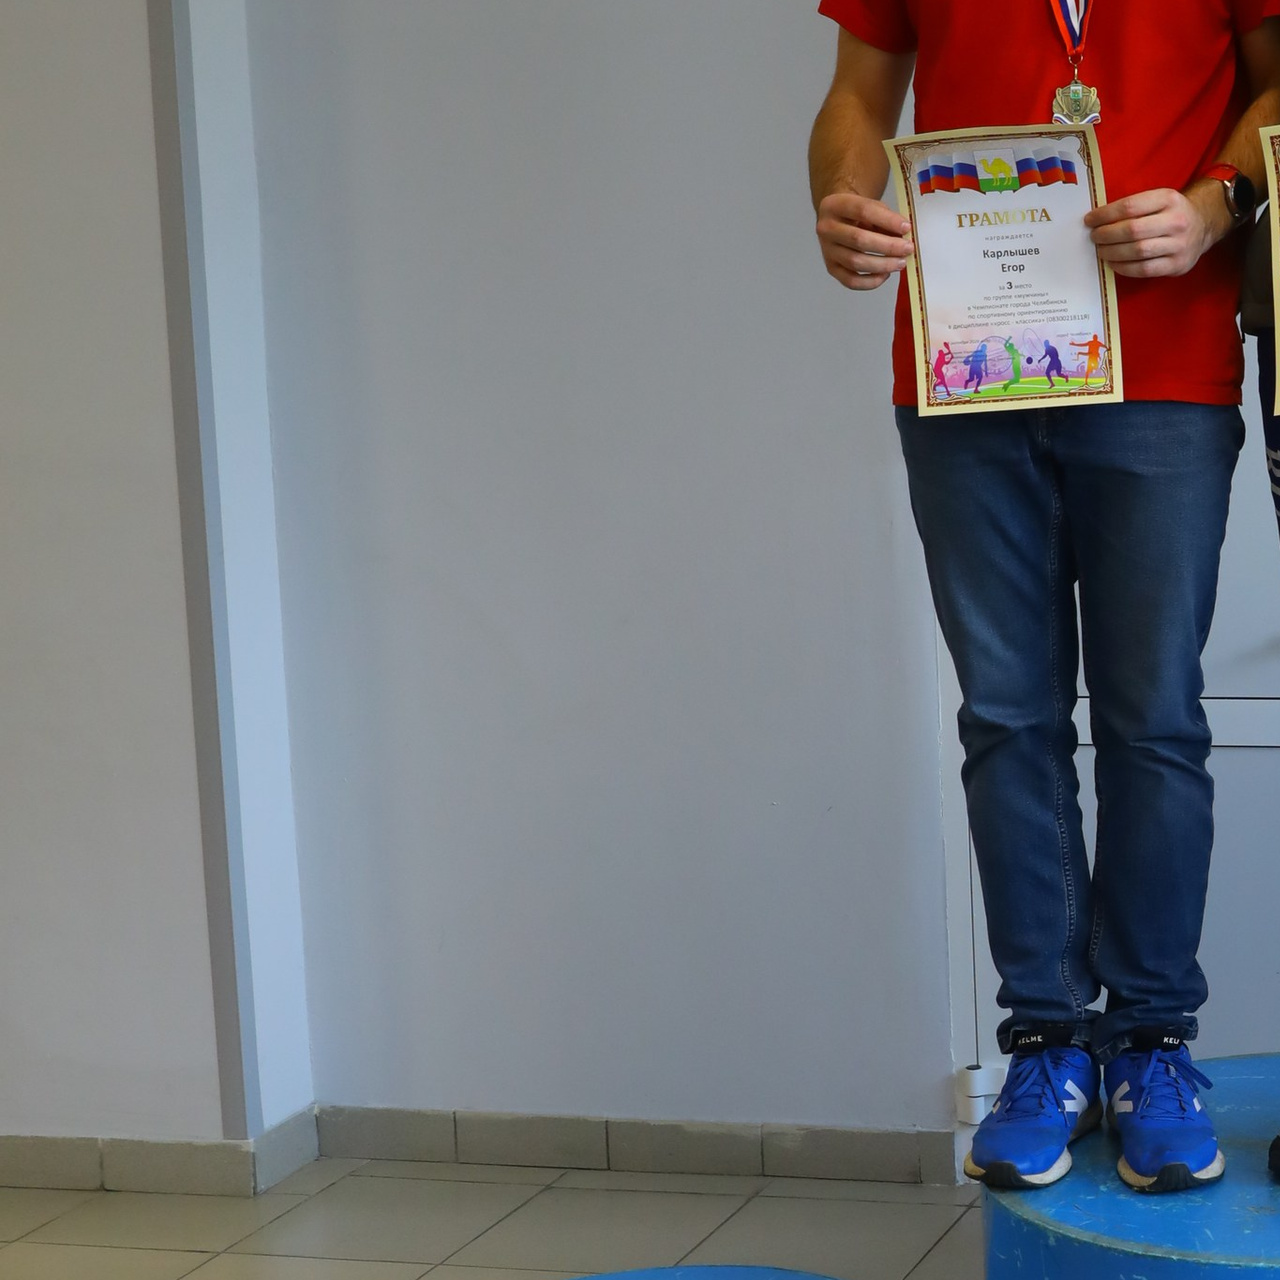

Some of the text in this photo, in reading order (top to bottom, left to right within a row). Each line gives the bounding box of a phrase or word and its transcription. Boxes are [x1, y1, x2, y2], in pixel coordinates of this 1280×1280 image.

[956, 207, 1052, 228] ГРАМОТА
[985, 233, 1034, 241] награждается
[983, 247, 1040, 259] Карлышев
[1001, 263, 1025, 273] Егор
[1006, 282, 1013, 290] 3
[972, 303, 1008, 311] Чемпионате
[976, 311, 1016, 319] спортивному
[1017, 307, 1068, 317] ориентированию
[953, 321, 989, 330] дисциплине
